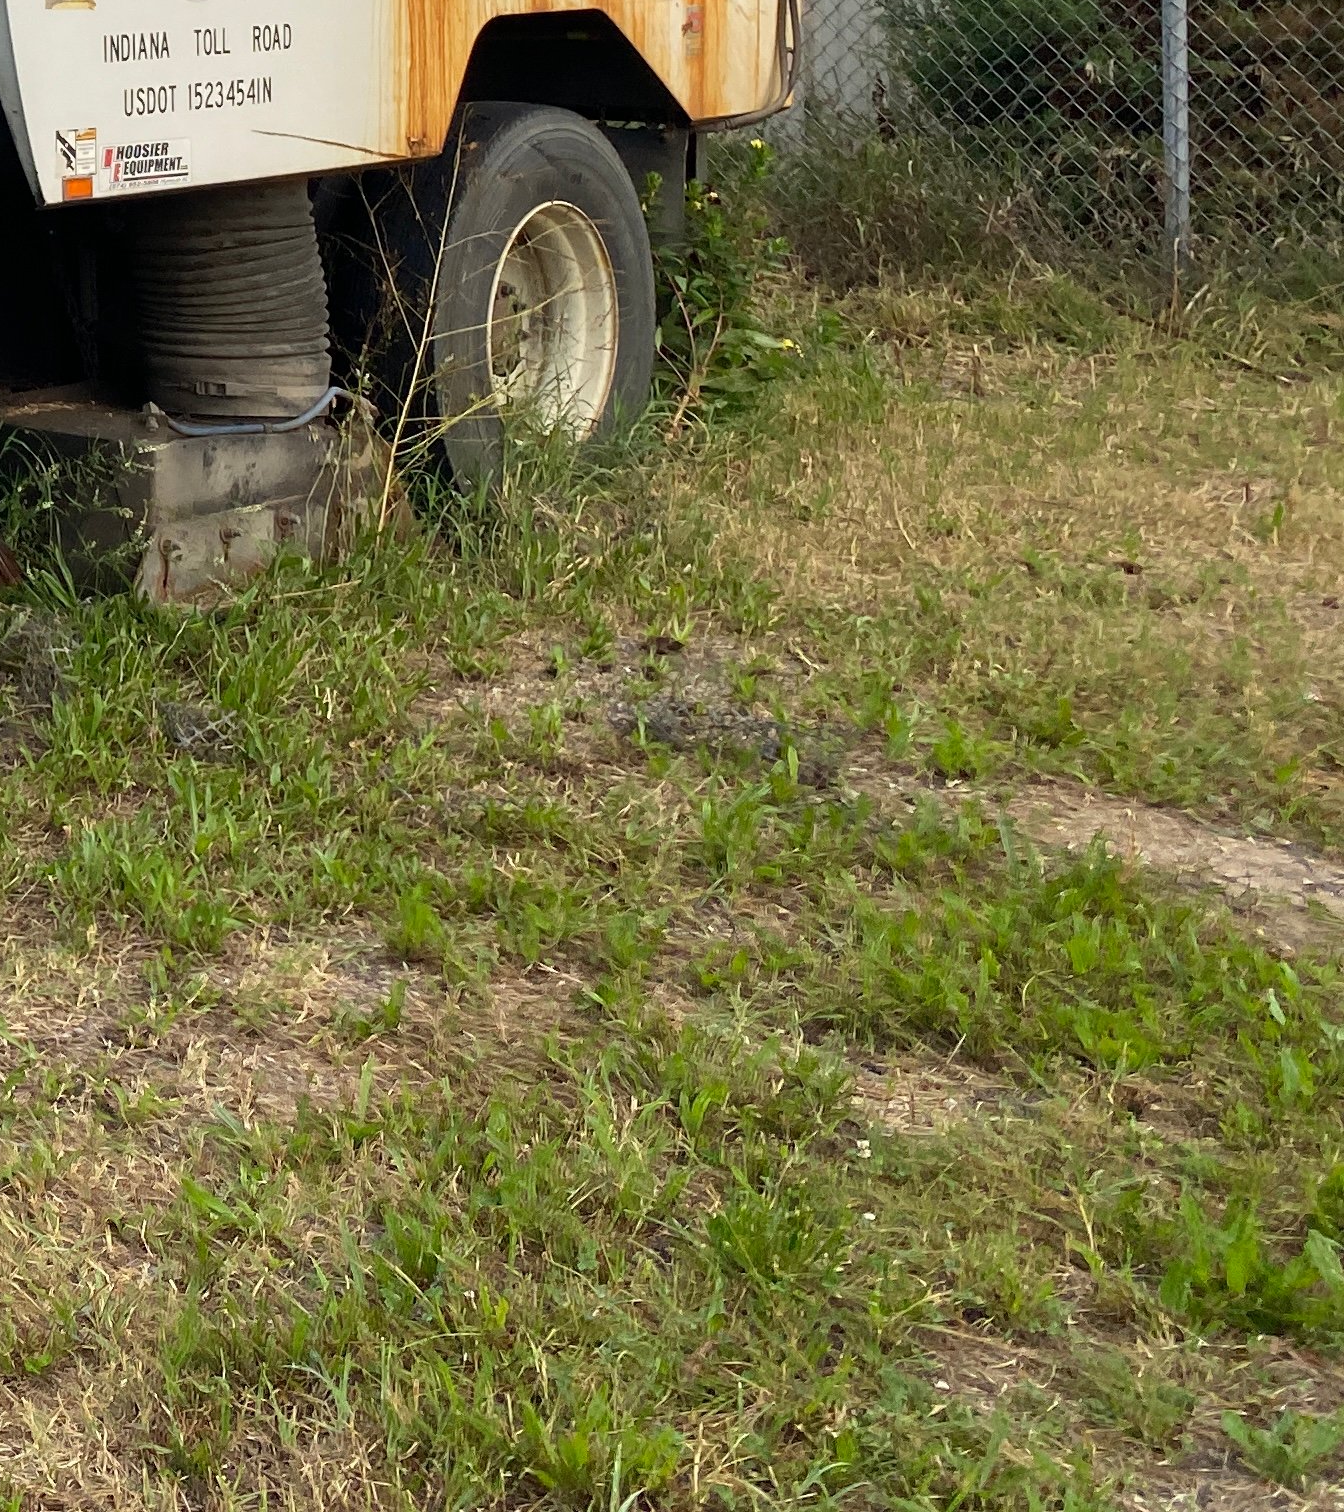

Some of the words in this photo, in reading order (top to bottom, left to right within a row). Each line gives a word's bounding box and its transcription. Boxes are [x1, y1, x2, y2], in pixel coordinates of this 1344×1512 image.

[103, 31, 170, 63] INDIANA
[194, 27, 231, 56] TOLL
[252, 23, 292, 52] ROAD
[124, 85, 176, 117] USDOT
[116, 142, 169, 160] HOOSIER
[123, 157, 182, 176] EQUIPMENT
